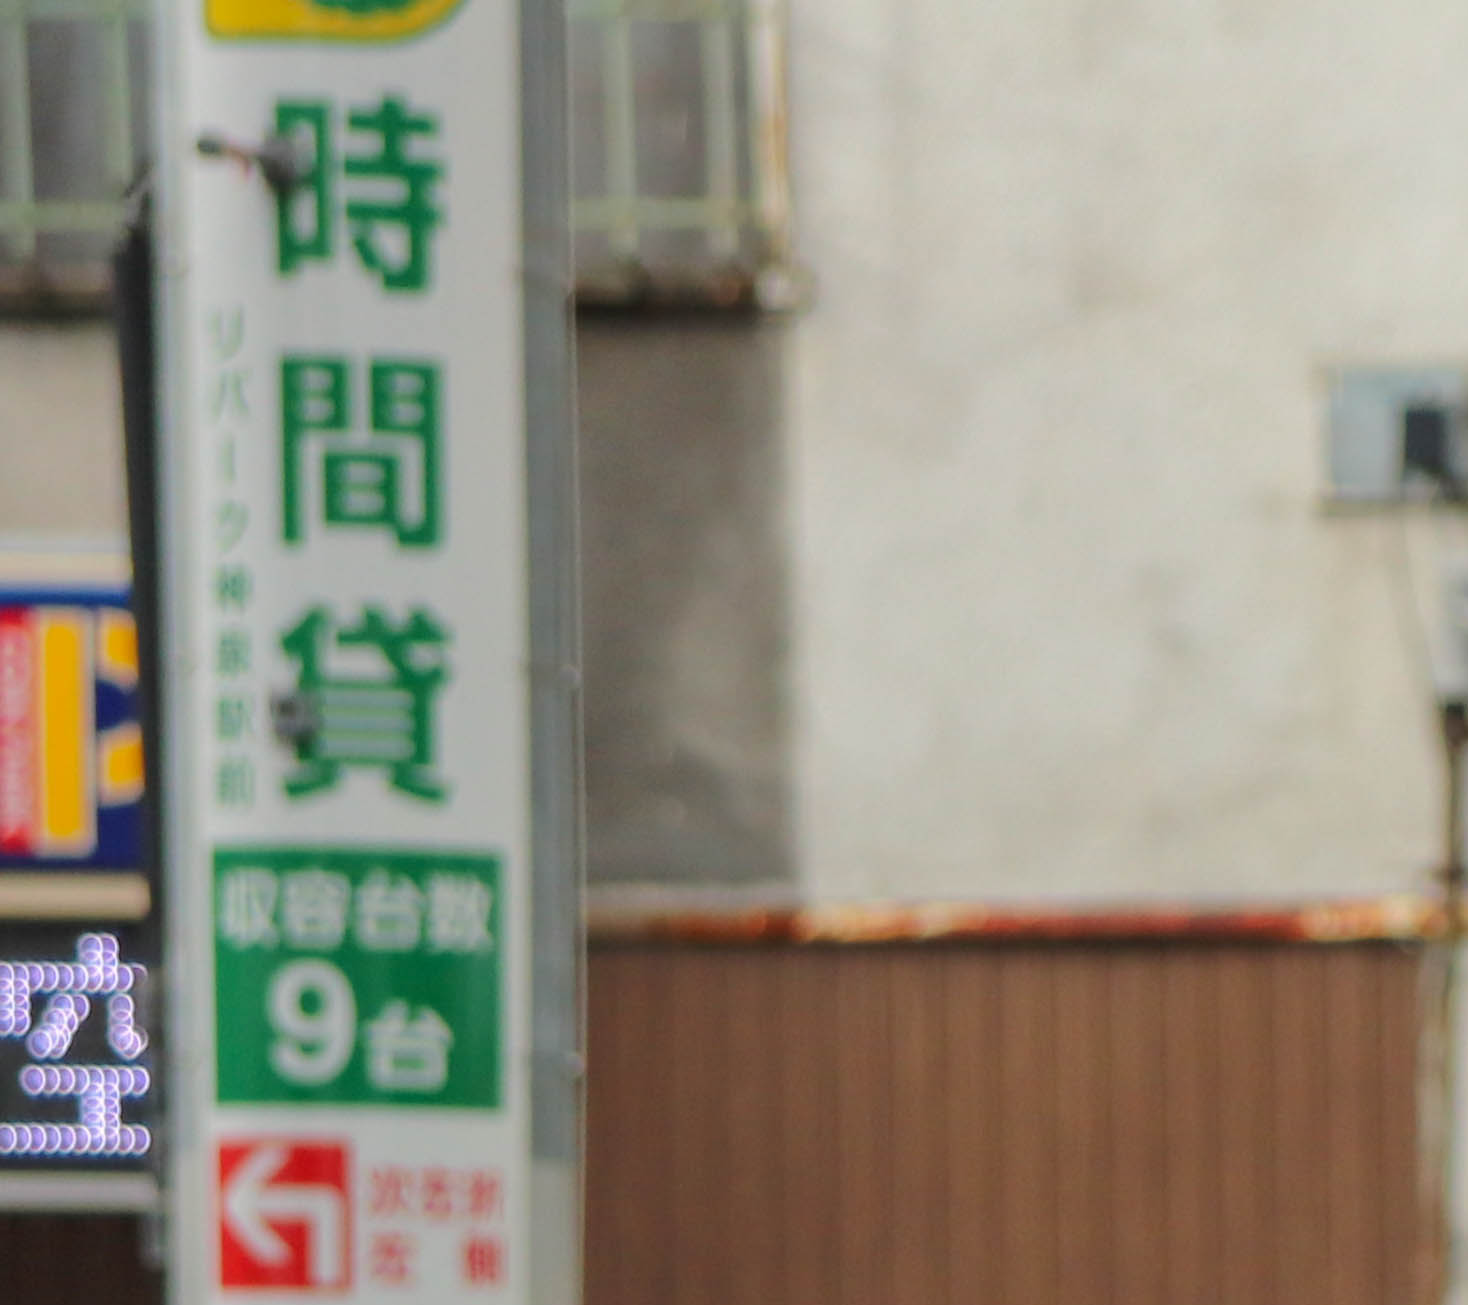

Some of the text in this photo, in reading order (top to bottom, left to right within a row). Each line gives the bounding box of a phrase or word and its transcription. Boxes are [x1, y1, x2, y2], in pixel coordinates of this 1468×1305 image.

[275, 95, 450, 800] 時間貸
[221, 866, 493, 954] 収容台数
[266, 957, 453, 1092] 9台
